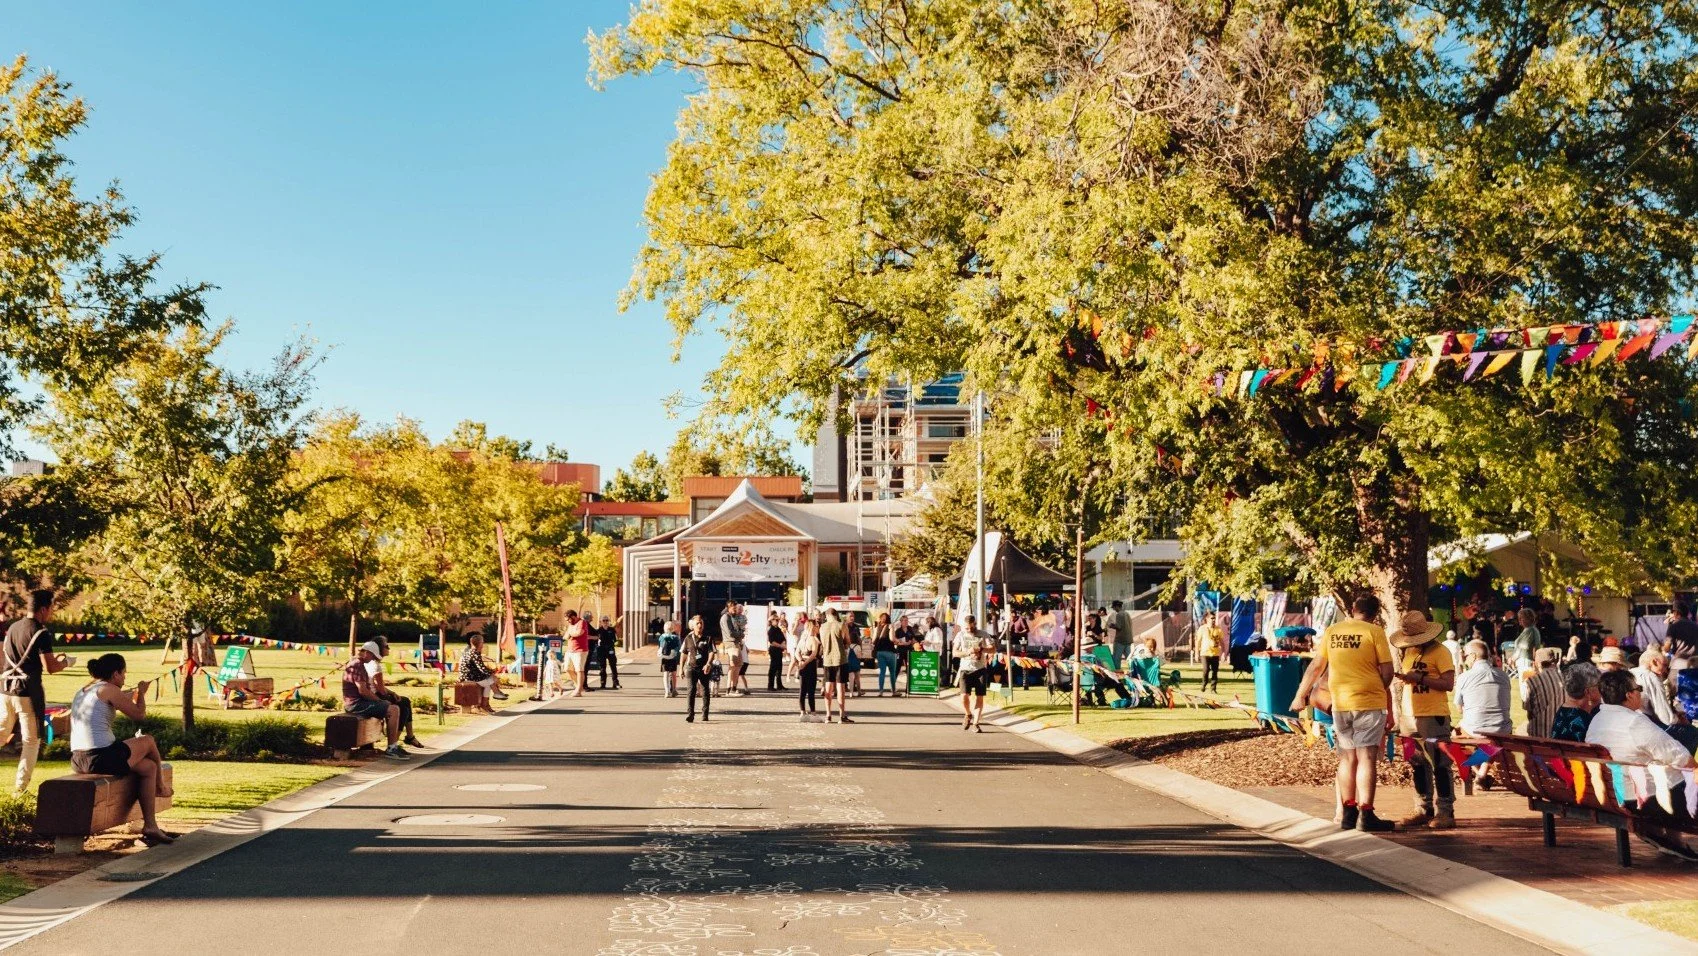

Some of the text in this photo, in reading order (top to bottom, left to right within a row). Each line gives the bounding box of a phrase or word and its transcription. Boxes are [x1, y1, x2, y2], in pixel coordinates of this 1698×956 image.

[721, 550, 770, 566] city2city
[1331, 634, 1363, 642] EVENT
[1331, 641, 1361, 649] CREW
